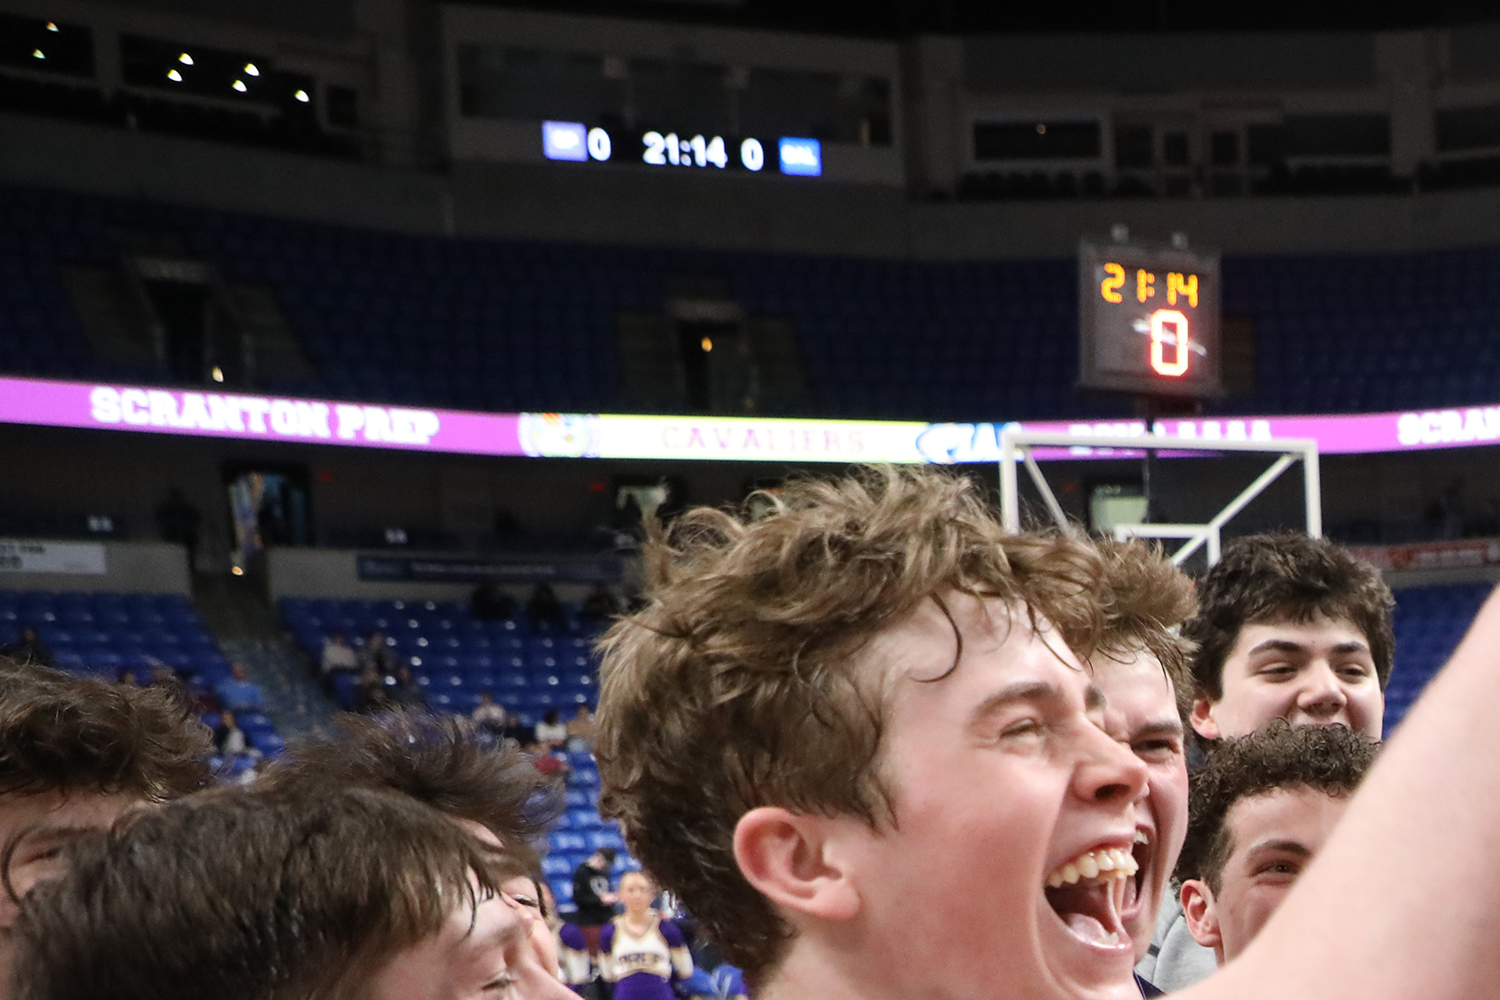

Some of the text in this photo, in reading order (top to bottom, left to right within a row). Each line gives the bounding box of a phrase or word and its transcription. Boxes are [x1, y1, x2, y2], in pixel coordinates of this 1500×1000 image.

[587, 127, 611, 161] 0
[642, 131, 728, 168] 21:14
[740, 137, 764, 171] 0
[1101, 262, 1199, 308] 21:14
[1150, 308, 1189, 377] 0
[90, 386, 440, 444] SCRANTON PREP
[661, 427, 865, 453] CAVALIERS
